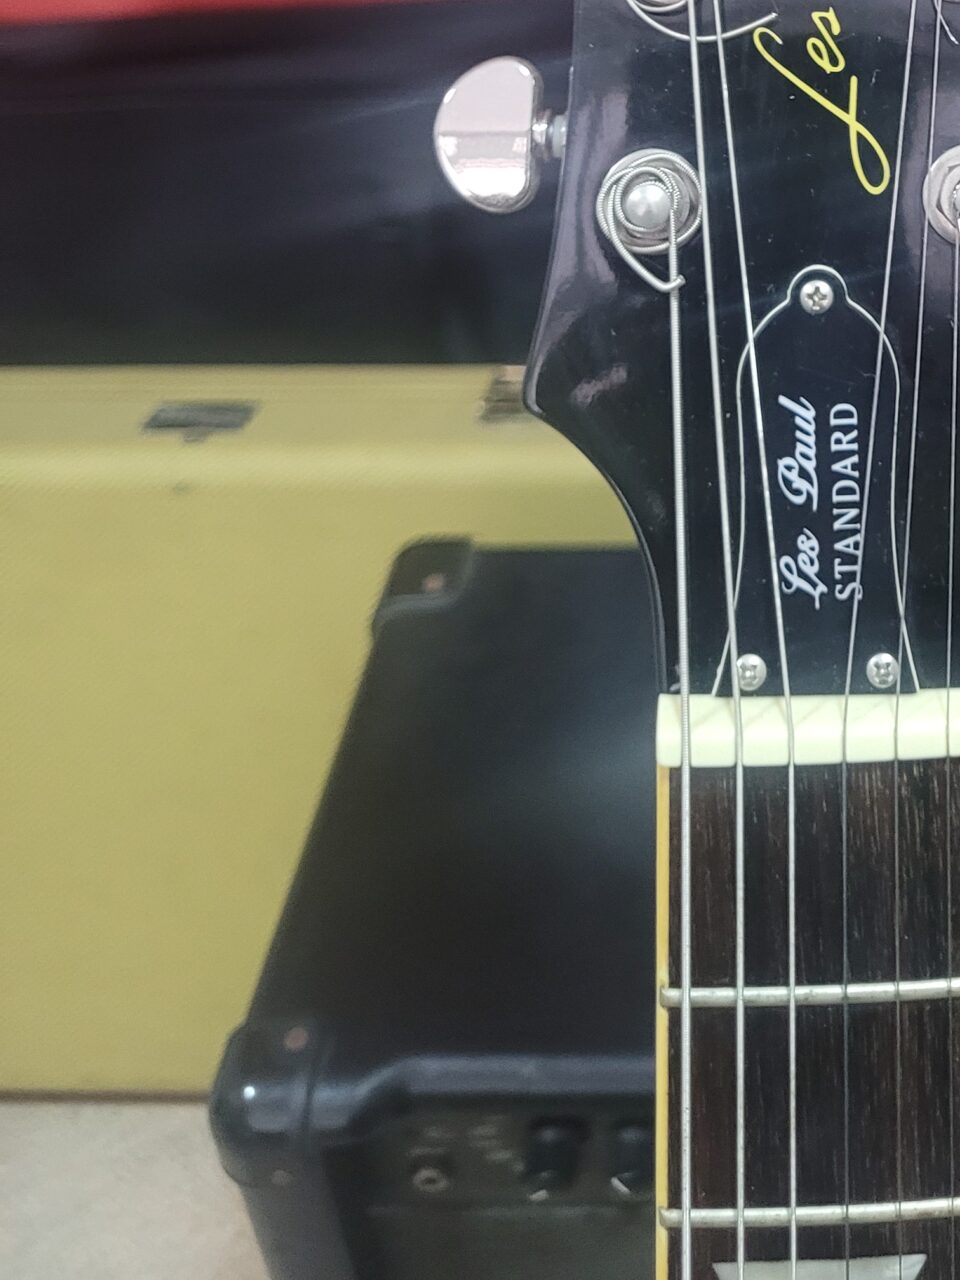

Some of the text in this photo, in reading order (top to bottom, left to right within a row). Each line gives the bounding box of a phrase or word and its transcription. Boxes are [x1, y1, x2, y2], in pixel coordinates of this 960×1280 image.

[753, 8, 890, 195] Les
[777, 394, 828, 610] Les Paul
[829, 402, 864, 602] STANDARD
